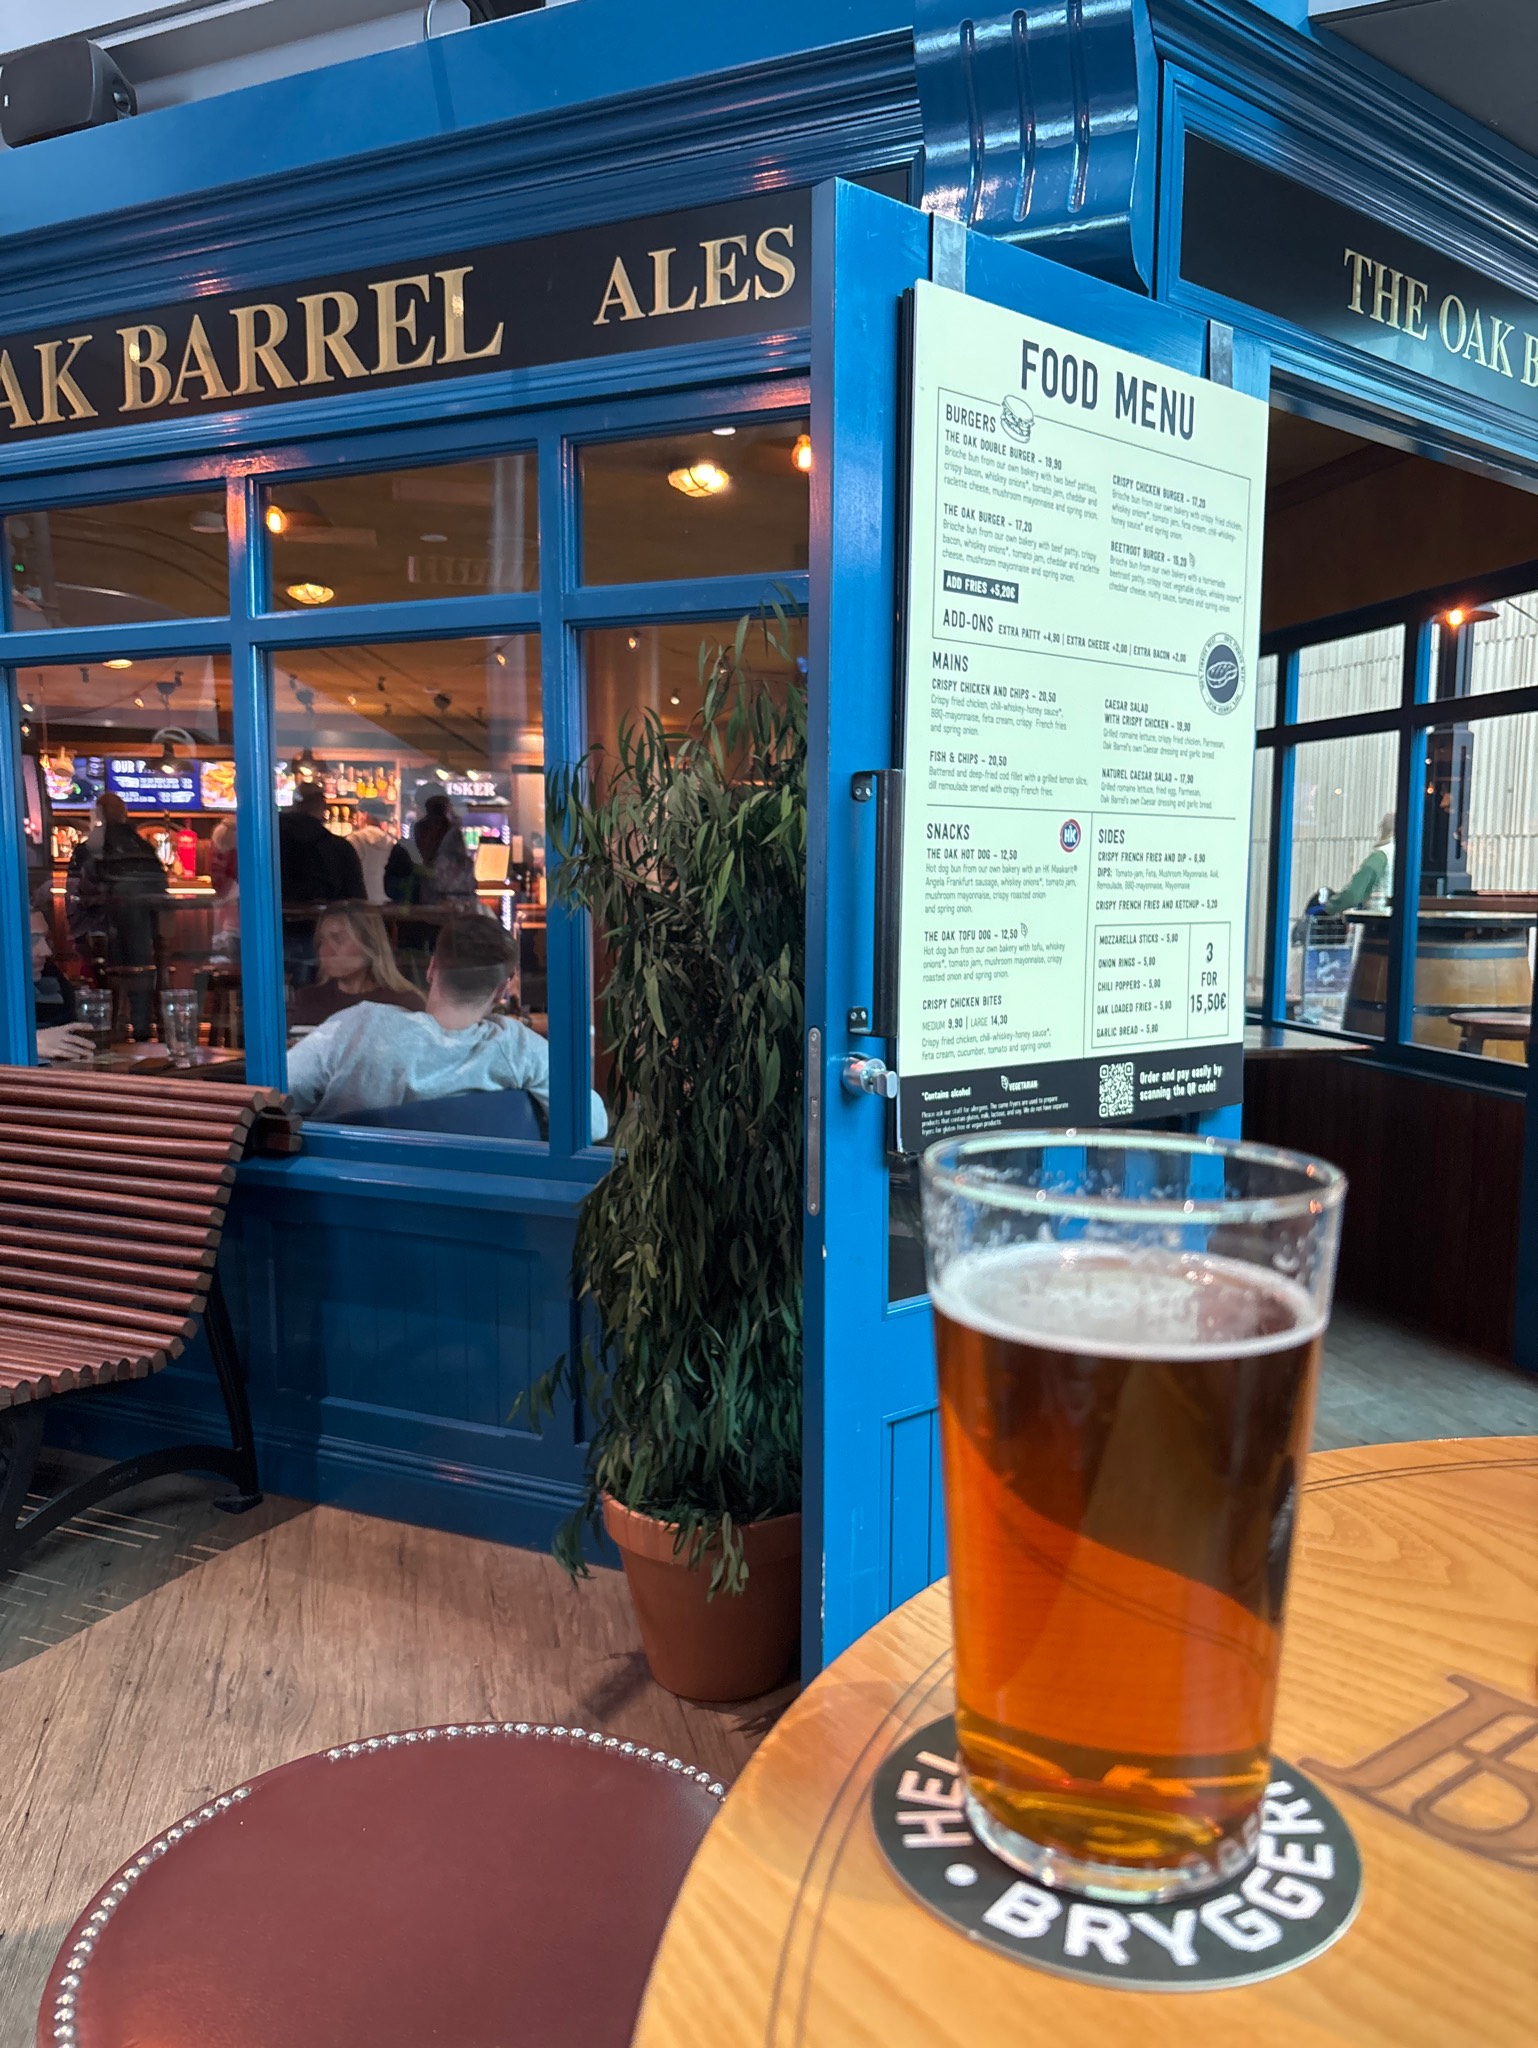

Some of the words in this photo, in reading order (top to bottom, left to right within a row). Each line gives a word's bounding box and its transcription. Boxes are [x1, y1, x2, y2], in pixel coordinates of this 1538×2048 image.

[115, 265, 505, 414] BARREL
[592, 224, 796, 326] ALES
[1343, 247, 1429, 342] THE
[1438, 294, 1514, 378] OAK
[1021, 338, 1098, 410] FOOD
[1115, 370, 1195, 441] MENU
[945, 403, 996, 434] BURGERS
[944, 428, 960, 444] THE
[962, 433, 978, 449] OAK
[980, 438, 1007, 456] DOUBLE
[1009, 445, 1036, 464] BURGER
[1044, 455, 1062, 471] 19,90
[1112, 474, 1134, 490] CRISPY
[1135, 480, 1161, 497] CHICKEN
[1162, 487, 1184, 503] BURGER
[1191, 495, 1206, 509] 17,20
[943, 502, 959, 517] THE
[960, 506, 976, 521] OAK
[978, 510, 1005, 527] BURGER
[1015, 518, 1033, 533] 17,20
[1110, 540, 1141, 557] BEETROOT
[1142, 547, 1165, 563] BURGER
[945, 574, 962, 590] ADD
[964, 577, 988, 594] FRIES
[989, 583, 1016, 599] +5,20€
[942, 608, 994, 633] ADD-ONS
[997, 623, 1019, 637] EXTRA
[1021, 627, 1041, 640] PATTY
[1042, 631, 1061, 644] +4,90
[1066, 634, 1086, 647] EXTRA
[1087, 637, 1110, 652] CHEESE
[1132, 645, 1151, 657] EXTRA
[1152, 648, 1170, 661] BACON
[932, 651, 969, 672] MAINS
[931, 677, 958, 692] CRISPY
[959, 681, 991, 695] CHICKEN
[992, 685, 1008, 698] AND
[1009, 687, 1030, 700] CHIPS
[1038, 690, 1057, 703] 20,50
[1104, 698, 1128, 711] CAESAR
[1129, 701, 1149, 714] SALAD
[1103, 712, 1120, 725] WITH
[1121, 714, 1143, 727] CRISPY
[1144, 717, 1169, 730] CHICKEN
[1176, 720, 1191, 732] 19,90
[929, 749, 947, 762] FISH
[957, 752, 979, 765] CHIPS
[987, 754, 1007, 767] 20,50
[928, 764, 955, 778] Battered
[955, 768, 968, 778] and
[968, 768, 998, 781] deep-fried
[998, 771, 1010, 781] cod
[1010, 770, 1023, 782] fillet
[1023, 772, 1036, 782] with
[1041, 773, 1058, 786] grilled
[1058, 774, 1075, 785] lemon
[1075, 775, 1088, 786] slice,
[1101, 767, 1128, 780] NATUREL
[1129, 769, 1153, 781] CAESAR
[1153, 771, 1173, 783] SALAD
[926, 822, 970, 840] SNACKS
[1098, 828, 1125, 844] SIDES
[926, 847, 941, 859] THE
[943, 847, 958, 859] OAK
[960, 848, 975, 860] HOT
[977, 848, 991, 860] DOG
[1000, 848, 1018, 861] 12,50
[1097, 850, 1119, 862] CRISPY
[1120, 851, 1144, 862] FRENCH
[1145, 851, 1163, 863] FRIES
[1163, 852, 1176, 863] AND
[1177, 852, 1187, 863] DIP
[1096, 866, 1113, 877] DIPS:
[924, 903, 936, 914] and
[936, 904, 955, 916] spring
[955, 905, 973, 914] onion.
[1095, 899, 1117, 911] CRISPY
[1118, 899, 1142, 910] FRENCH
[1143, 899, 1160, 910] FRIES
[1161, 899, 1174, 910] AND
[1174, 899, 1200, 910] KETCHUP
[1206, 898, 1218, 909] 5,20
[923, 930, 939, 942] THE
[941, 930, 955, 942] OAK
[958, 929, 976, 941] TOFU
[978, 929, 992, 940] DOG
[1000, 928, 1018, 940] 12,50
[1098, 933, 1137, 945] MOZZARELLA
[1138, 933, 1159, 944] STICKS
[923, 945, 935, 956] Hot
[935, 945, 947, 958] dog
[947, 945, 959, 955] bun
[959, 943, 975, 954] from
[975, 945, 985, 954] our
[986, 945, 998, 953] own
[998, 943, 1018, 955] bakery
[1018, 942, 1031, 952] with
[1031, 941, 1045, 952] tofu,
[1045, 941, 1066, 952] whiskey
[1206, 941, 1214, 963] 3
[1097, 957, 1116, 969] ONION
[1118, 956, 1136, 967] RINGS
[1097, 981, 1113, 992] CHILI
[1114, 979, 1141, 991] POPPERS
[1200, 970, 1218, 987] FOR
[922, 998, 947, 1010] CRISPY
[949, 996, 980, 1008] CHICKEN
[982, 994, 1002, 1006] BITES
[1096, 1004, 1109, 1015] OAK
[1110, 1002, 1134, 1014] LOADED
[1135, 1001, 1152, 1012] FRIES
[1190, 991, 1227, 1014] 15,50€
[922, 1020, 945, 1031] MEDIUM
[947, 1017, 963, 1030] 9,90
[970, 1016, 988, 1028] LARGE
[990, 1013, 1008, 1026] 14,30
[1096, 1026, 1117, 1038] GARLIC
[1118, 1024, 1138, 1036] BREAD
[1139, 1070, 1160, 1085] Order
[1161, 1068, 1175, 1082] and
[1176, 1069, 1190, 1085] pay
[1191, 1064, 1212, 1083] easily
[1212, 1063, 1223, 1078] by
[950, 1086, 971, 1098] alcohol
[1008, 1079, 1038, 1092] VEGETARIAN
[1139, 1085, 1172, 1101] scanning
[1172, 1083, 1186, 1097] the
[1186, 1081, 1197, 1097] QR
[1197, 1078, 1217, 1094] code!
